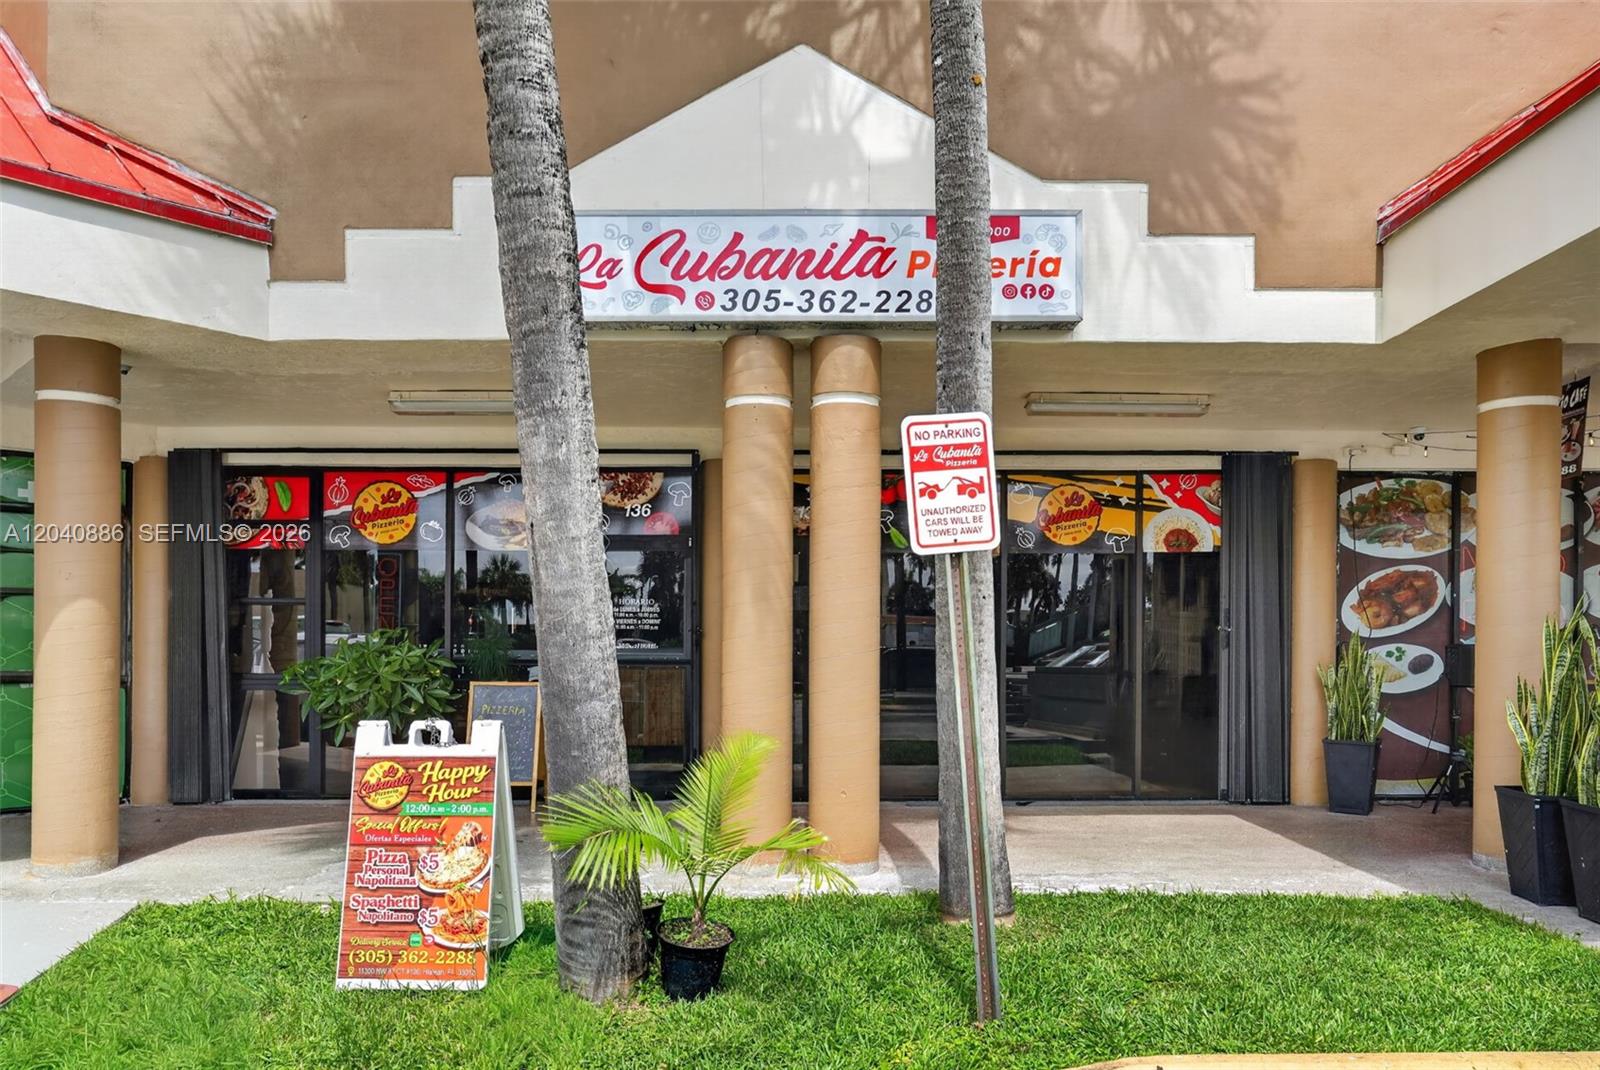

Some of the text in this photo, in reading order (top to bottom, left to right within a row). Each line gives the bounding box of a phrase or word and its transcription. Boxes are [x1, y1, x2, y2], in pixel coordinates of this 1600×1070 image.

[634, 228, 899, 306] Cubanita
[906, 249, 1062, 279] Pería
[719, 287, 933, 314] 305-362-228
[914, 427, 981, 441] NO PARKING
[932, 444, 983, 464] Cubanita
[945, 458, 978, 467] Pizzeria
[351, 497, 419, 531] Cubanita
[624, 503, 652, 518] 136
[920, 504, 986, 517] UNAUTHORIZED
[1036, 500, 1103, 533] Cubanita
[371, 518, 405, 530] Pizzeria
[925, 515, 984, 527] CARS WILL BE
[1055, 521, 1087, 532] Pizzeria
[928, 526, 983, 538] TOWED AWAY
[619, 598, 655, 606] HORARIO
[416, 760, 491, 786] Happy
[421, 784, 482, 804] Hour
[405, 804, 430, 814] 12:00
[451, 804, 472, 814] 2:00
[353, 816, 449, 836] Special Offers!
[364, 834, 432, 844] Ofertas Especiales
[366, 848, 409, 865] Pizza
[419, 854, 441, 872] $5
[363, 864, 410, 876] Personal
[355, 874, 417, 888] Napolitana
[350, 893, 420, 911] Spaghetti
[357, 910, 415, 923] Napolitano
[418, 909, 440, 927] $5
[348, 949, 476, 966] (305) 362-2288
